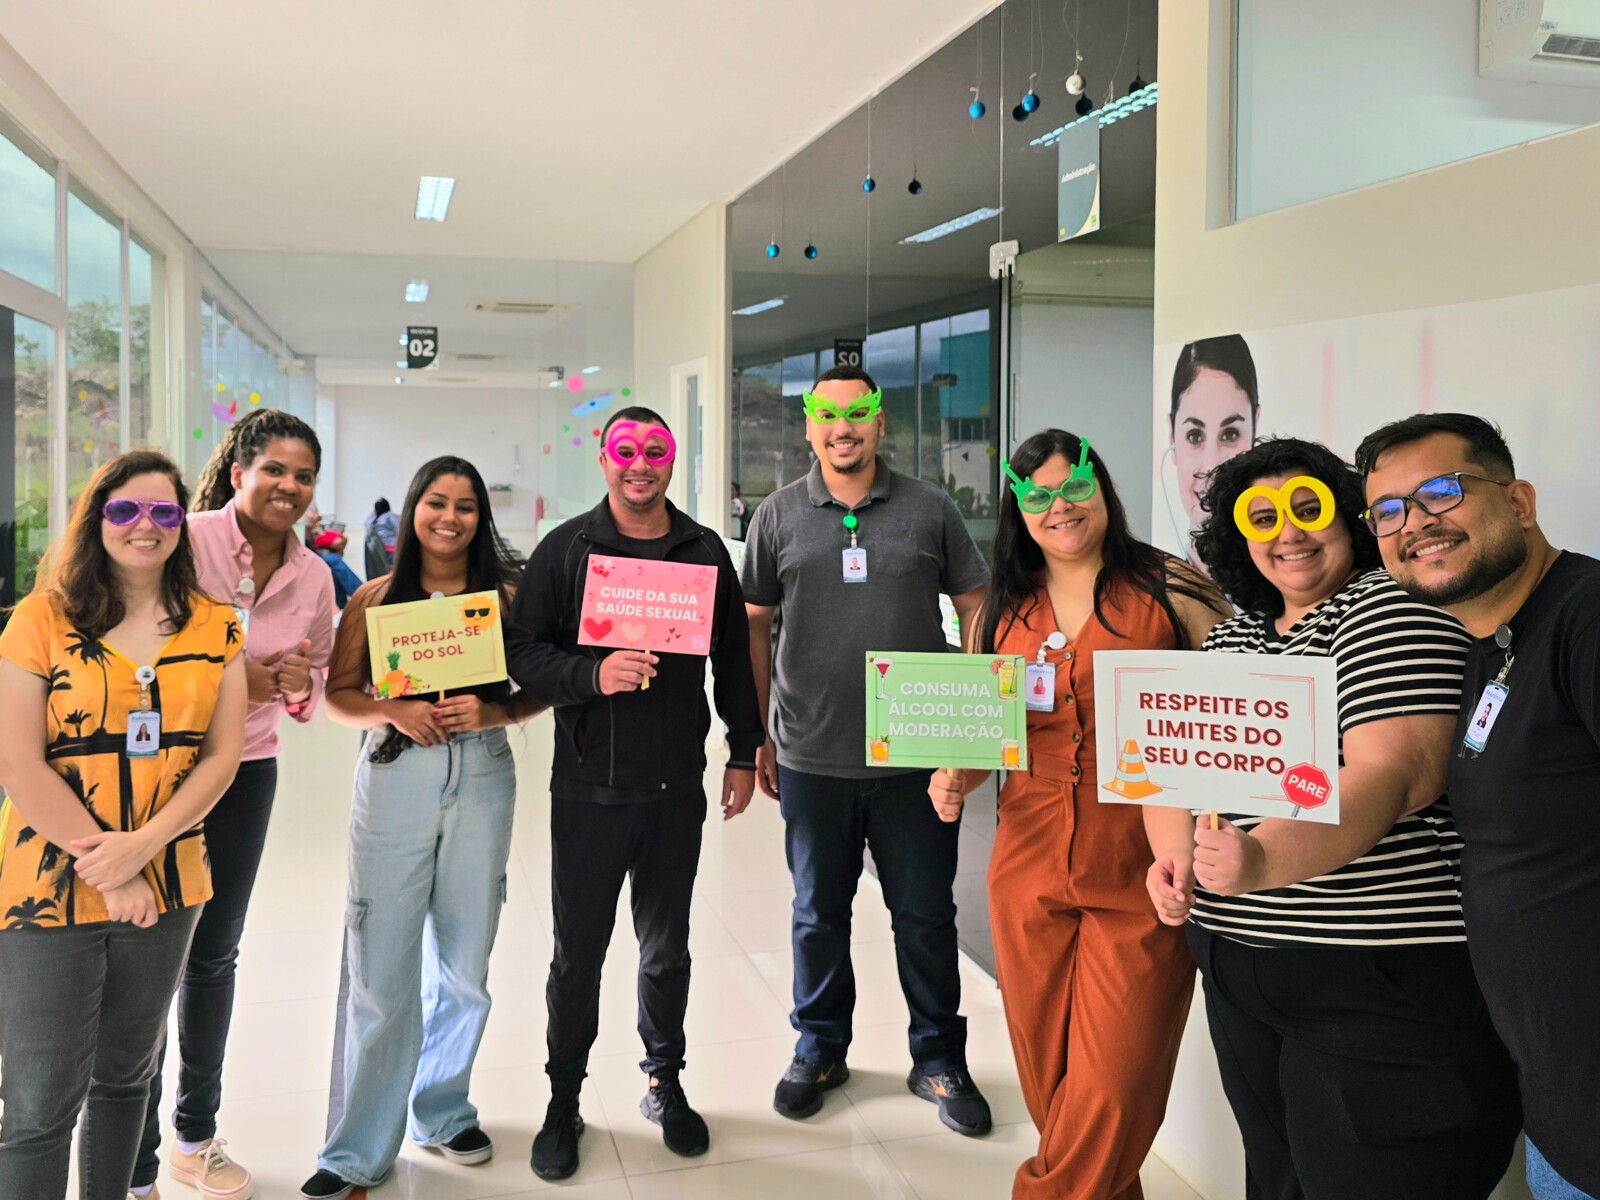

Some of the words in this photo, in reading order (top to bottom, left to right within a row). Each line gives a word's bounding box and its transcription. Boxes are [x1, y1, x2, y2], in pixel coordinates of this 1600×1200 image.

[409, 338, 435, 357] 02
[600, 586, 643, 600] CUIDE
[645, 590, 666, 603] DA
[669, 592, 698, 606] SUA
[595, 600, 643, 617] SAÚDE
[645, 606, 699, 622] SEXUAL
[391, 625, 481, 648] PROTEJA-SE
[412, 648, 434, 662] DO
[438, 644, 464, 658] SOL
[900, 682, 991, 697] CONSUMA
[888, 698, 957, 717] ÁLCOOL
[961, 703, 1003, 718] COM
[1139, 692, 1248, 716] RESPEITE
[1253, 699, 1289, 719] OS
[888, 721, 1003, 742] MODERAÇÃO
[1146, 719, 1238, 743] LIMITES
[1244, 726, 1282, 747] DO
[1144, 745, 1188, 766] SEU
[1194, 750, 1285, 775] CORPO
[1287, 774, 1327, 799] PARE
